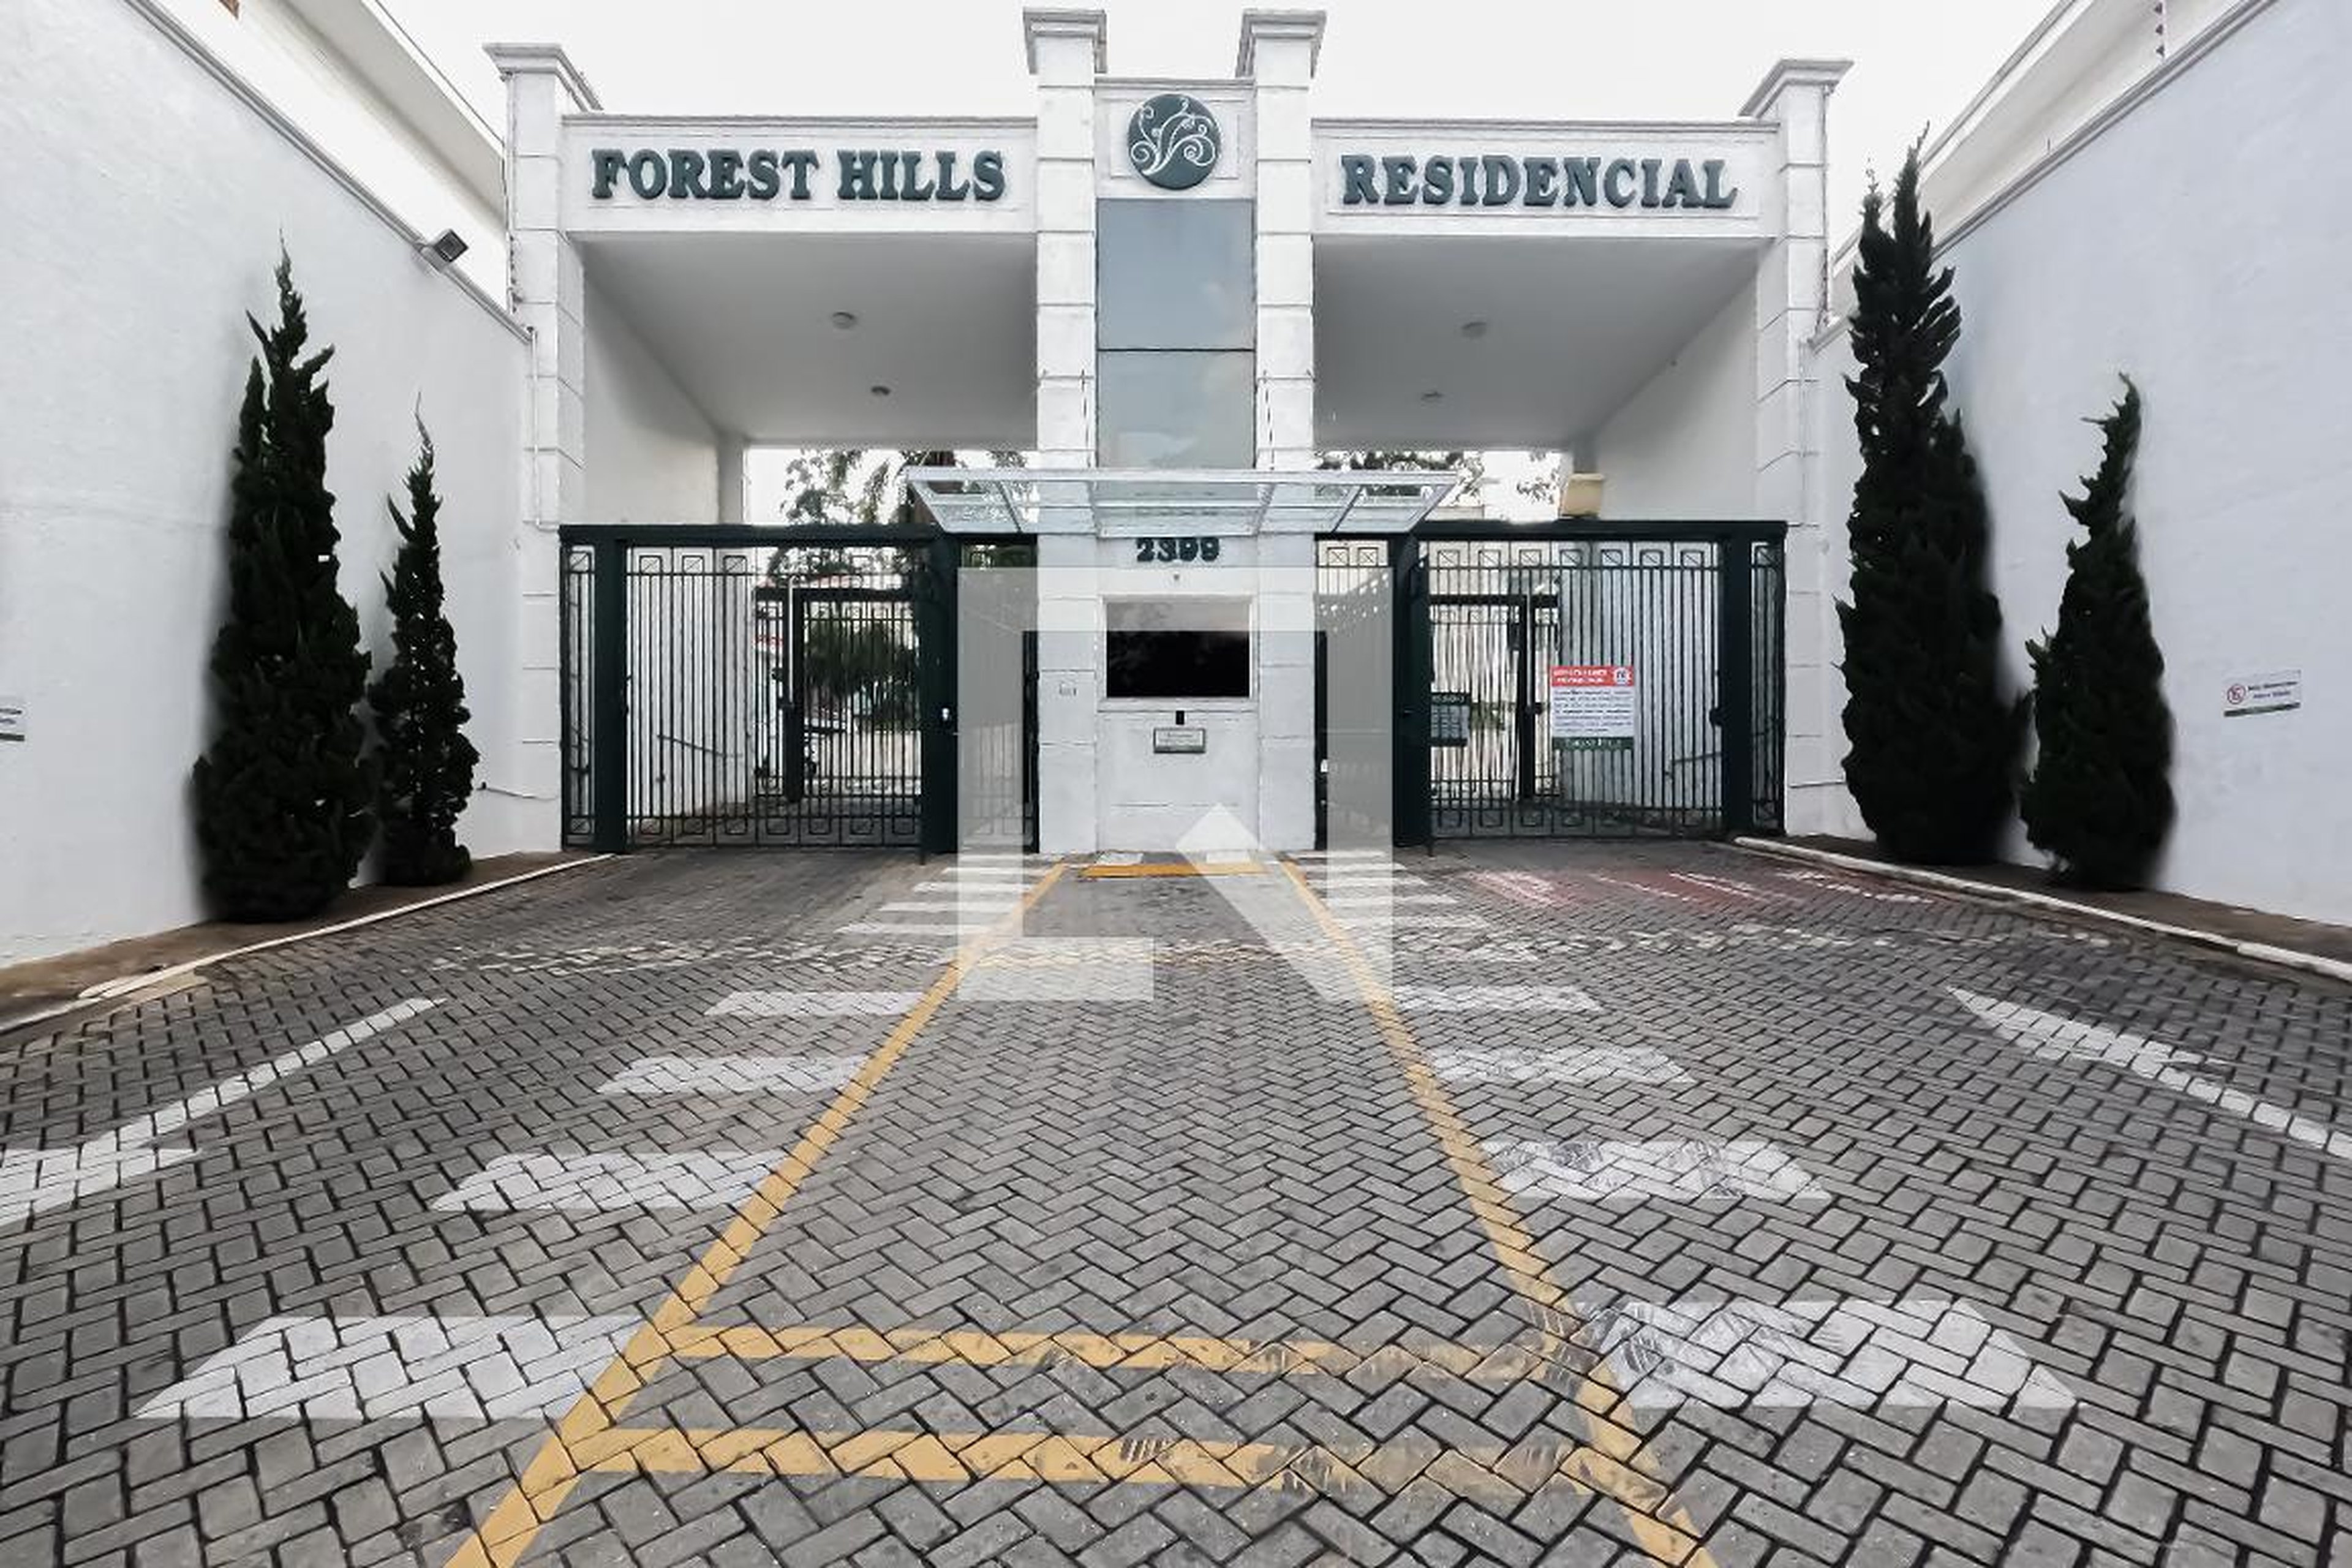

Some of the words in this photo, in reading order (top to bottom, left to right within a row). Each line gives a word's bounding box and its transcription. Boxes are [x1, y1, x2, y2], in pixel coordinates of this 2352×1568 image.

[592, 149, 820, 201] FOREST
[837, 149, 1006, 202] HILLS
[1341, 154, 1738, 209] RESIDENCIAL
